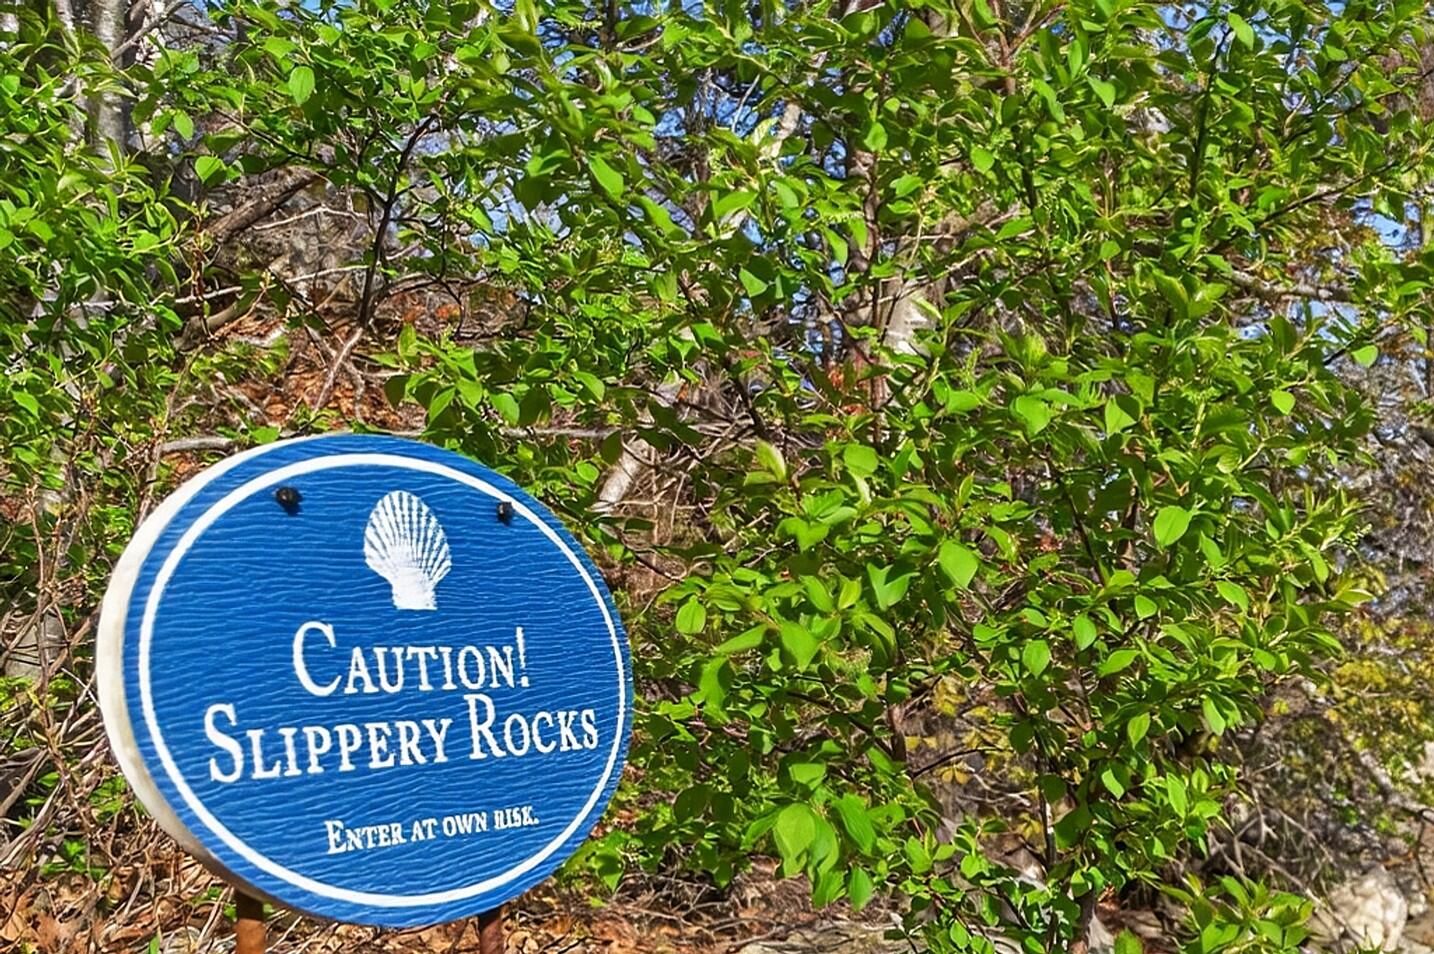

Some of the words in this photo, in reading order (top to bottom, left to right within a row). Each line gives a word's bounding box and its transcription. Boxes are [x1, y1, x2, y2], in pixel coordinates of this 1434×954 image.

[292, 621, 530, 697] CAUTION!
[203, 703, 453, 783] SLIPPERY
[463, 693, 599, 761] ROCKS
[324, 819, 407, 855] ENTER
[410, 819, 438, 842] AT
[442, 811, 488, 838] OWN
